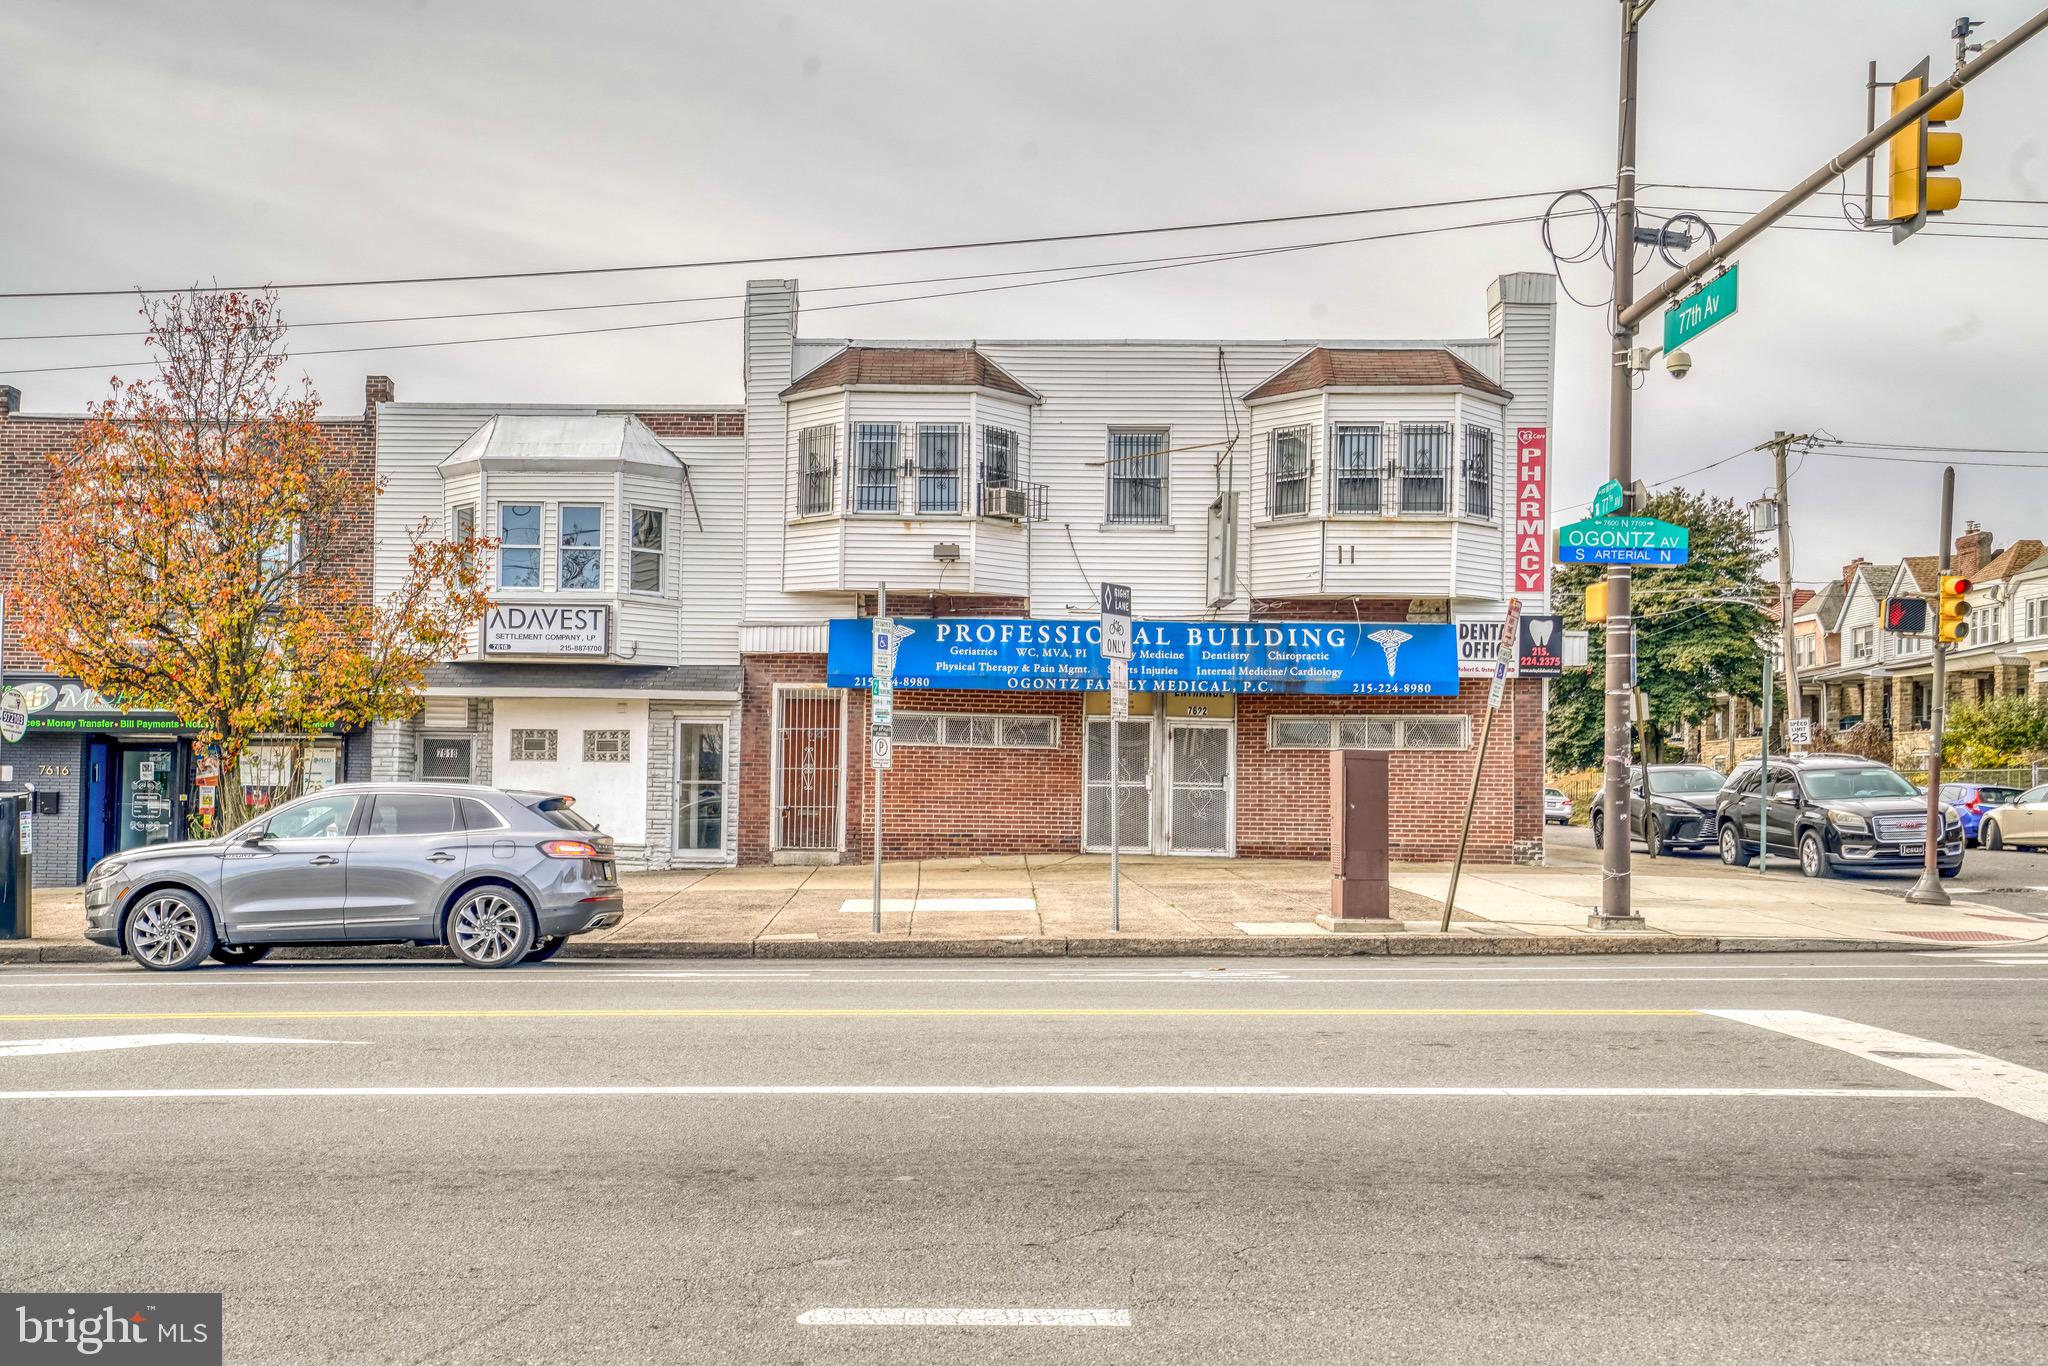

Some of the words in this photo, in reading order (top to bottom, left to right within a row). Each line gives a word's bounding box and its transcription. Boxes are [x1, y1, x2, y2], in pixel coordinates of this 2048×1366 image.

[1679, 304, 1702, 335] 77th
[1704, 295, 1720, 320] Av
[1517, 447, 1545, 589] PHARMACY
[1621, 519, 1629, 528] N
[1568, 530, 1655, 548] OGONTZ
[1660, 537, 1679, 548] AV
[1575, 548, 1585, 561] S
[1594, 549, 1651, 561] ARTERIAL
[1660, 550, 1671, 562] N
[1113, 587, 1130, 600] RIGHT
[1114, 601, 1130, 612] LANE
[489, 608, 603, 631] ADAVEST
[495, 633, 543, 641] SETTLEMENT
[545, 634, 585, 642] COMPANY,
[935, 623, 1171, 646] PROFESSIOAL
[1186, 627, 1346, 647] BUILDING
[1459, 623, 1505, 641] DENT
[1107, 638, 1126, 654] ONLY
[1462, 641, 1502, 659] OFFI
[1531, 646, 1550, 657] 215.
[950, 646, 998, 657] Geriatrics
[1015, 647, 1039, 659] WC,
[1042, 648, 1073, 659] MVA,
[1075, 648, 1087, 658] PI
[1139, 649, 1185, 660] Medicine
[1201, 650, 1250, 662] Dentistry
[1267, 651, 1330, 663] Chiropractic
[1520, 656, 1561, 666] 224.2375
[935, 661, 976, 673] Physical
[978, 663, 1019, 674] Therapy
[1021, 664, 1031, 673] &
[1033, 663, 1056, 673] Pain
[1058, 664, 1091, 676] Mgmt.
[1107, 665, 1138, 674] Sts
[1141, 665, 1179, 677] Injuries
[1196, 666, 1237, 676] Internal
[1238, 667, 1287, 677] Medicine/
[1289, 667, 1343, 679] Cardiology
[854, 676, 930, 687] 2154-8980
[1007, 677, 1080, 689] OGONTZ
[1086, 679, 1147, 691] FALY
[1153, 680, 1236, 693] MEDICAL,
[1243, 681, 1274, 692] P.C.
[1352, 683, 1432, 693] 215-224-8980
[47, 719, 76, 729] Money
[78, 719, 114, 728] Transfer
[120, 719, 135, 728] Bill
[136, 719, 180, 730] Payments
[1792, 732, 1808, 743] 25
[39, 765, 70, 776] 7616
